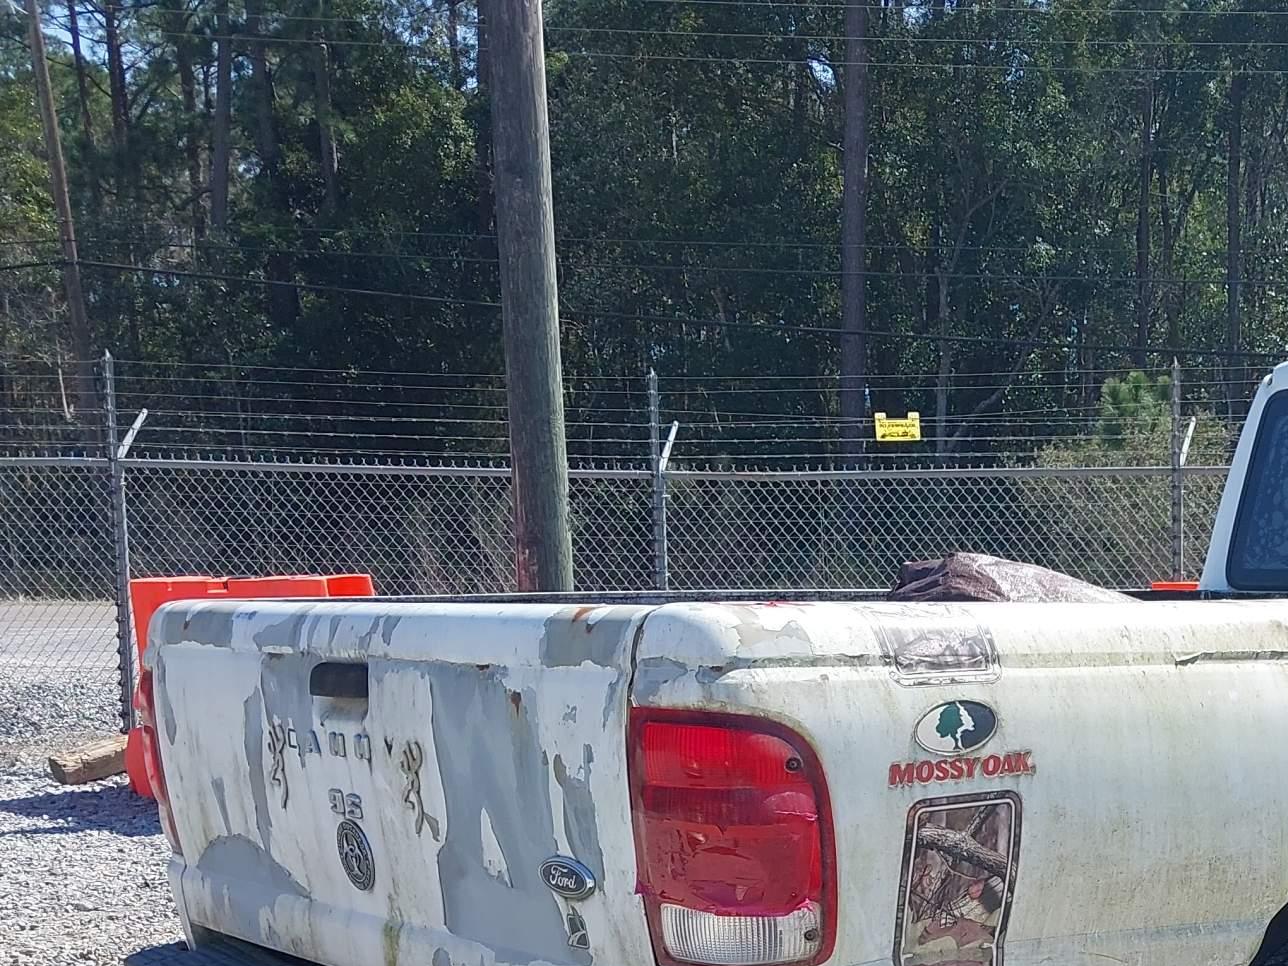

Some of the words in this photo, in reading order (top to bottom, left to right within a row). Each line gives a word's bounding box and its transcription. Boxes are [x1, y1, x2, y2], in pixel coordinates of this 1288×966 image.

[888, 756, 981, 786] MOSSY
[982, 750, 1032, 777] OAK
[549, 865, 577, 889] Ford
